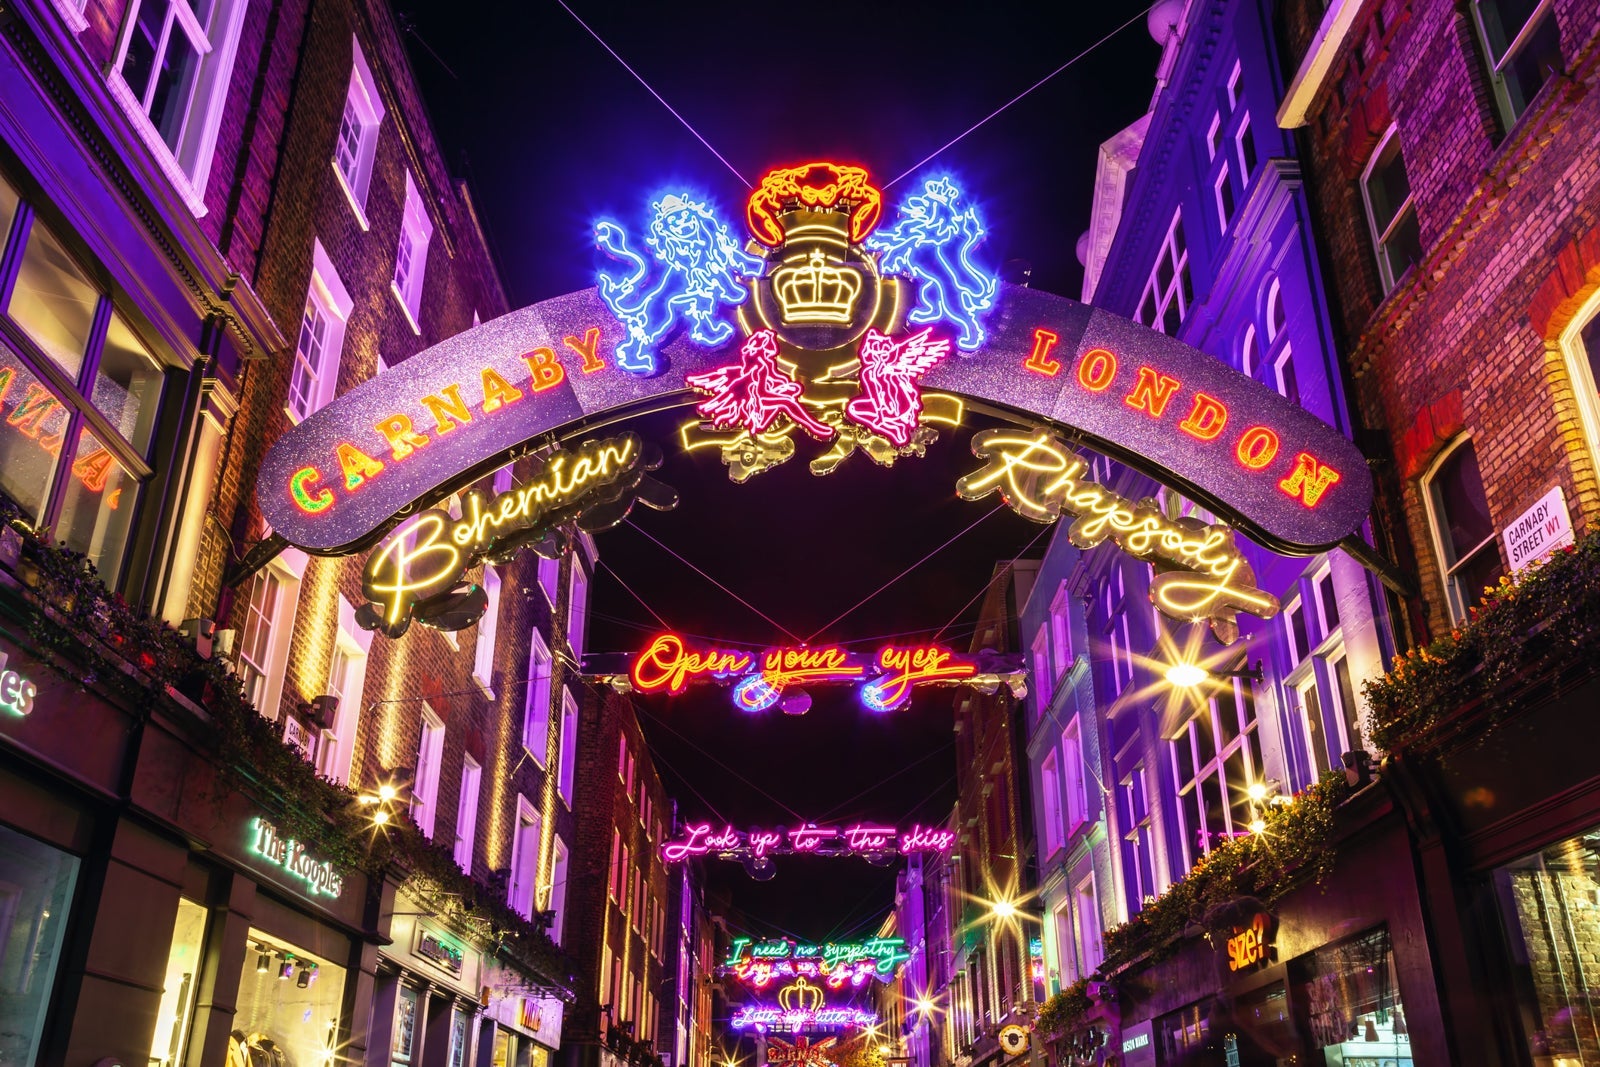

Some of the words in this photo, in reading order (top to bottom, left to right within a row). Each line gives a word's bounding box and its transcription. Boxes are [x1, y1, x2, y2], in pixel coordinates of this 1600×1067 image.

[289, 327, 606, 515] CARNABY
[1025, 329, 1340, 507] LONDON
[371, 437, 633, 625] Bohemian
[966, 434, 1272, 611] Rhapsody
[1508, 501, 1549, 546] CARNABY
[1512, 527, 1544, 563] STREET
[1544, 515, 1561, 537] W1
[634, 634, 750, 691] Open
[740, 647, 864, 706] your
[872, 647, 975, 706] eyes
[254, 818, 286, 865] The
[287, 839, 343, 898] Kooples
[664, 823, 740, 859] Look
[750, 831, 781, 856] up
[788, 824, 837, 850] to
[844, 823, 896, 850] the
[902, 824, 956, 851] skies
[726, 938, 750, 966] I
[752, 940, 790, 957] need
[795, 944, 818, 956] no
[823, 936, 911, 973] sympathy
[1227, 912, 1267, 972] size?
